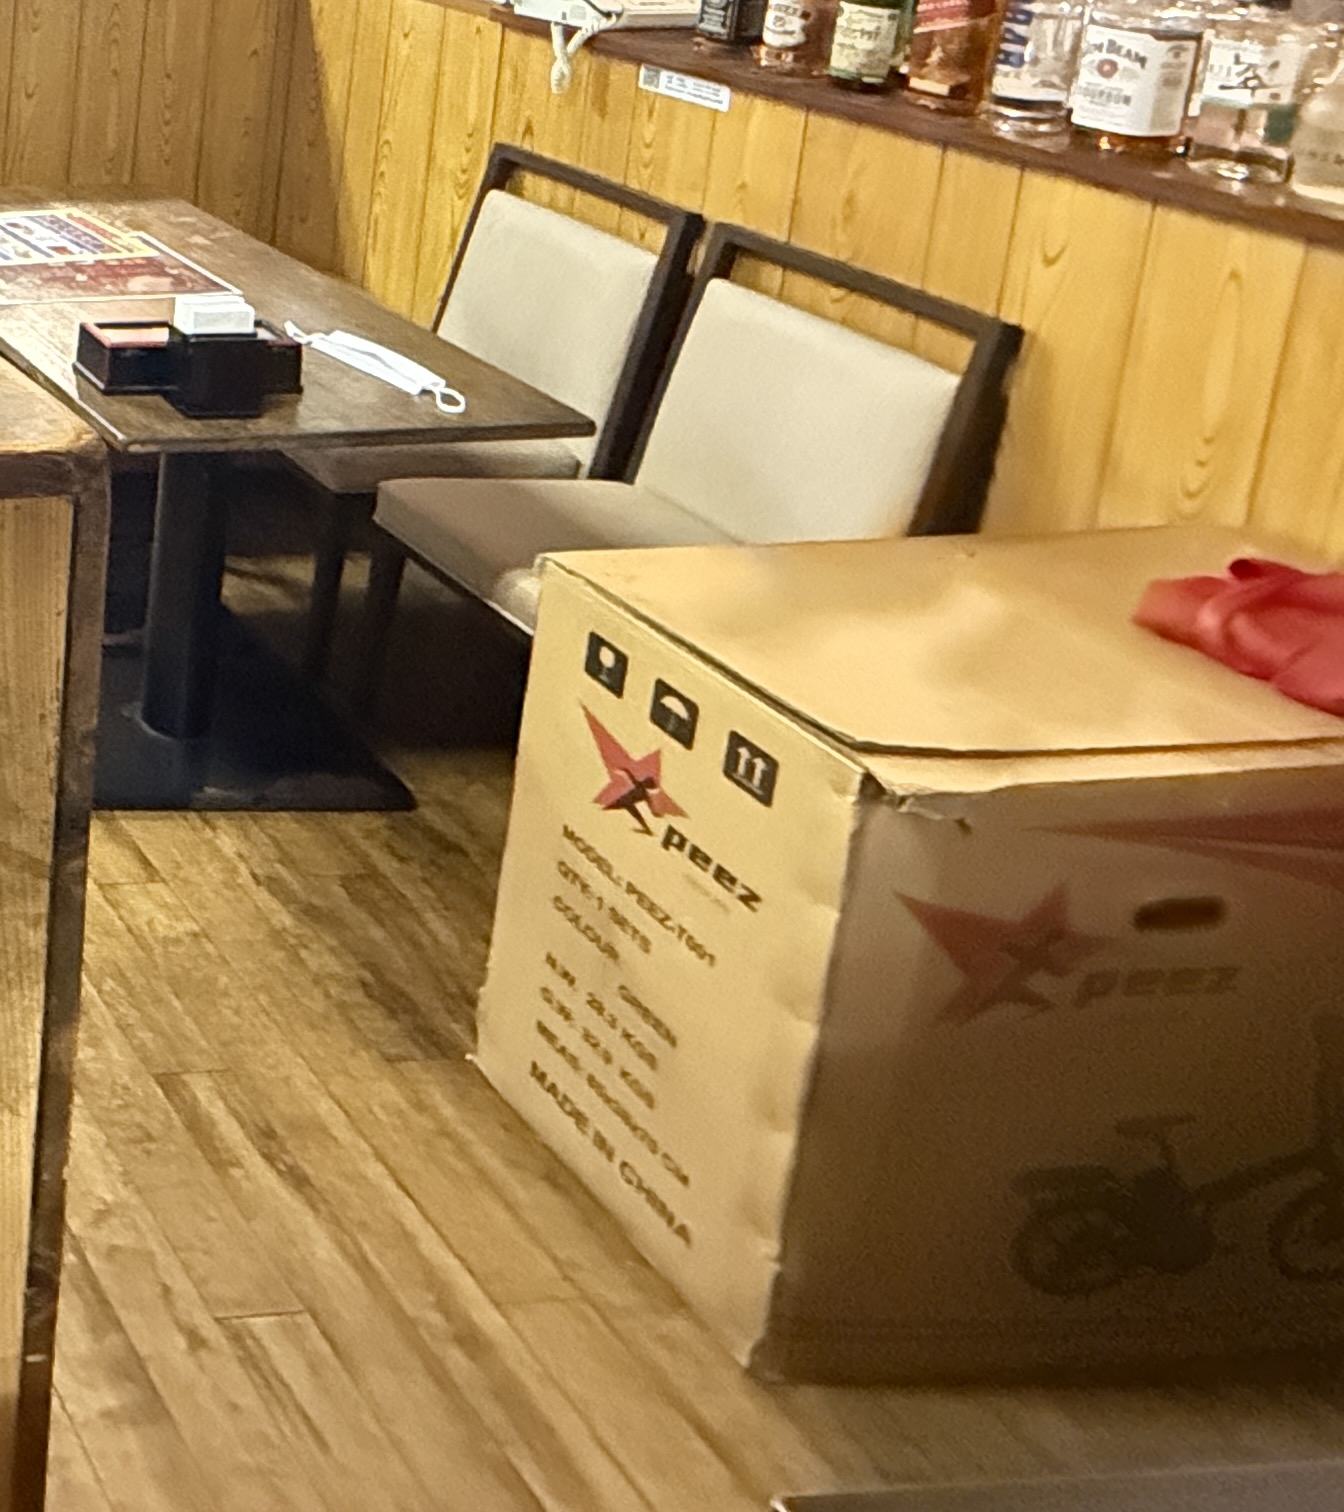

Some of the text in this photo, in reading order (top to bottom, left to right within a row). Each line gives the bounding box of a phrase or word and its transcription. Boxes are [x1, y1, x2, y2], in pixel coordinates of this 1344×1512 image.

[661, 824, 764, 913] peez
[1073, 966, 1243, 1009] peez
[529, 1060, 693, 1250] MADE IN CHINA
